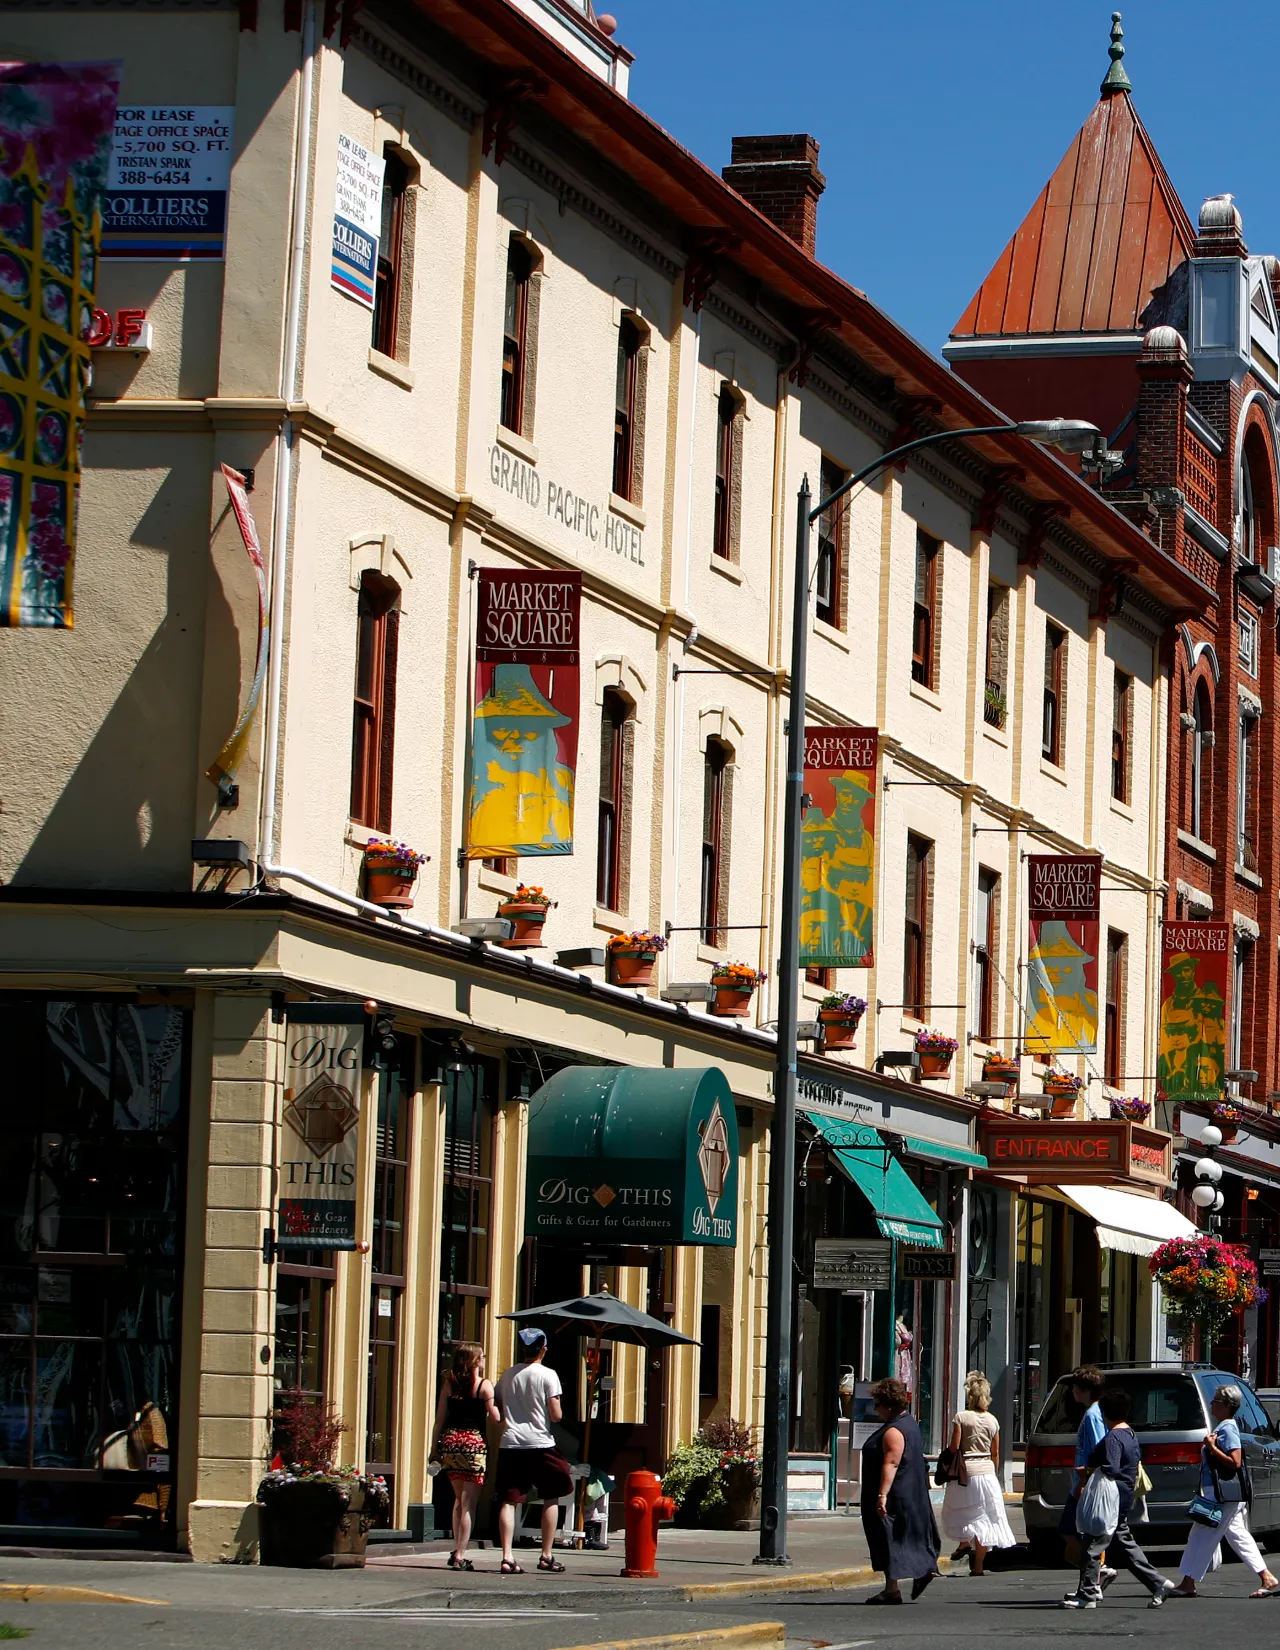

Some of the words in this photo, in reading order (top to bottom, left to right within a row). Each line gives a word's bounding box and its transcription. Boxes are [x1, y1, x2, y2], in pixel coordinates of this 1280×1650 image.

[116, 110, 145, 121] FOR
[152, 110, 195, 121] LEASE
[148, 126, 188, 137] OFFICE
[194, 126, 229, 137] SPACE
[172, 140, 200, 154] SQ.
[207, 140, 229, 151] FT.
[338, 134, 350, 150] FOR
[352, 143, 367, 162] LEASE
[117, 156, 157, 168] TRISTAN
[160, 158, 192, 168] SPARK
[118, 172, 190, 184] 388-6454
[101, 216, 208, 226] NTERNATIONAL
[332, 220, 372, 260] COLLIERS
[490, 445, 540, 508] GRAND
[547, 480, 600, 542] PACIFIC
[604, 514, 645, 568] HOTEL
[488, 581, 574, 611] MARKET
[485, 610, 574, 649] SQUARE
[804, 749, 874, 768] QUARE
[1034, 864, 1096, 884] MARKET
[1034, 884, 1096, 909] SQUARE
[1166, 928, 1227, 938] MARKET
[1165, 936, 1226, 952] SQUARE
[994, 1138, 1110, 1158] ENTRANCE
[283, 1161, 355, 1186] THIS
[537, 1178, 590, 1204] DIG
[618, 1188, 672, 1206] THIS
[325, 1212, 348, 1222] Gear
[537, 1214, 562, 1225] Gifts
[566, 1216, 573, 1225] &
[577, 1215, 600, 1226] Gear
[604, 1216, 618, 1226] for
[622, 1216, 672, 1227] Gardeners
[302, 1223, 348, 1234] ardeners
[712, 1219, 732, 1240] THIS
